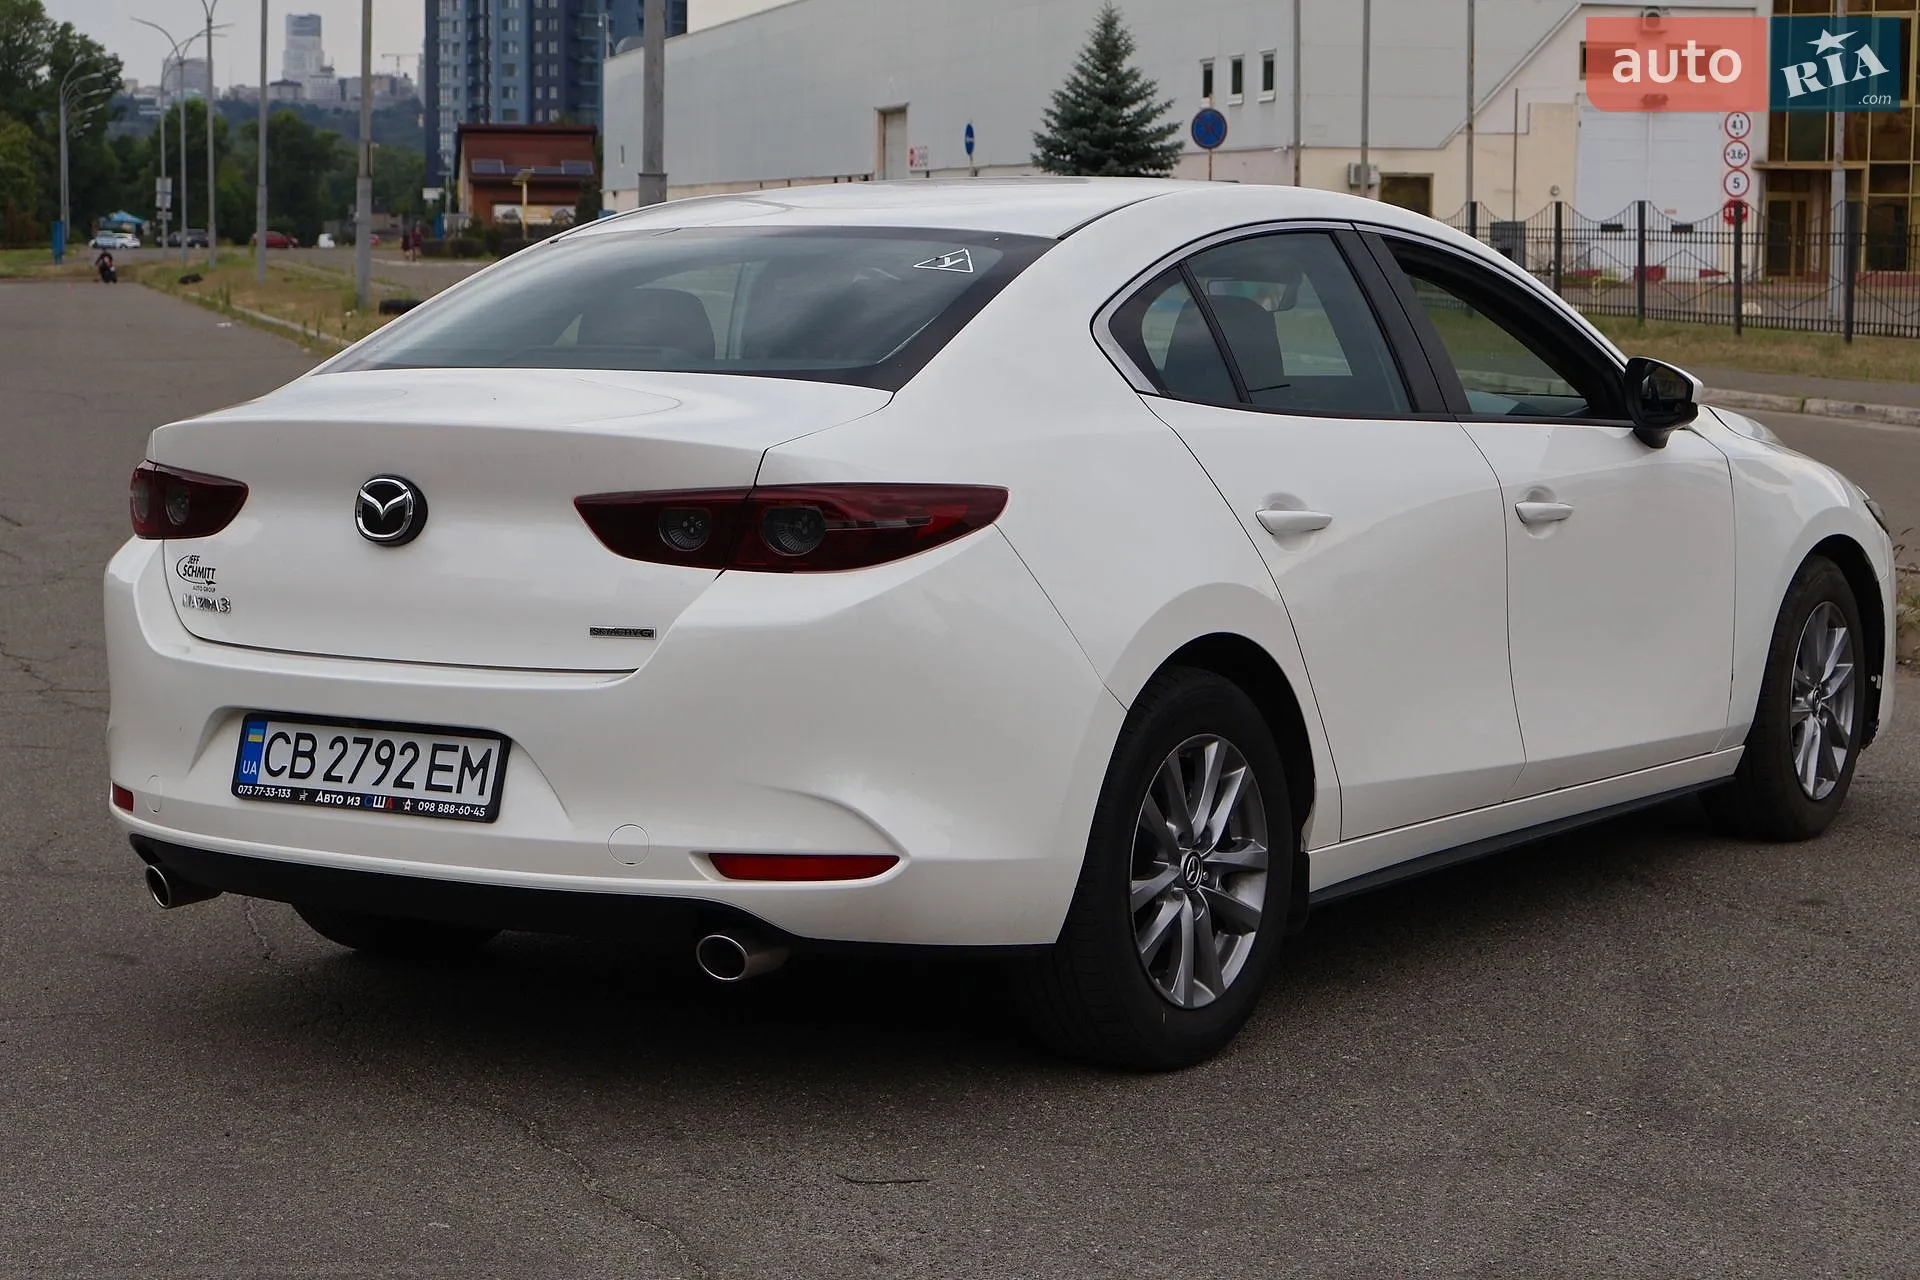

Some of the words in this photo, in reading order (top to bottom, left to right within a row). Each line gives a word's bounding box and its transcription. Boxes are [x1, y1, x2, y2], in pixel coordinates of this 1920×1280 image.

[1732, 177, 1741, 189] 5
[187, 554, 201, 565] JEFF
[182, 564, 217, 580] SCHMITT
[242, 760, 257, 776] UA
[263, 731, 318, 780] CB
[322, 735, 420, 790] 2792
[424, 742, 493, 797] EM
[238, 785, 253, 795] 073
[254, 786, 291, 799] 77-33-133
[363, 795, 393, 809] США
[418, 801, 435, 812] 098
[438, 803, 486, 817] 888-60-45
